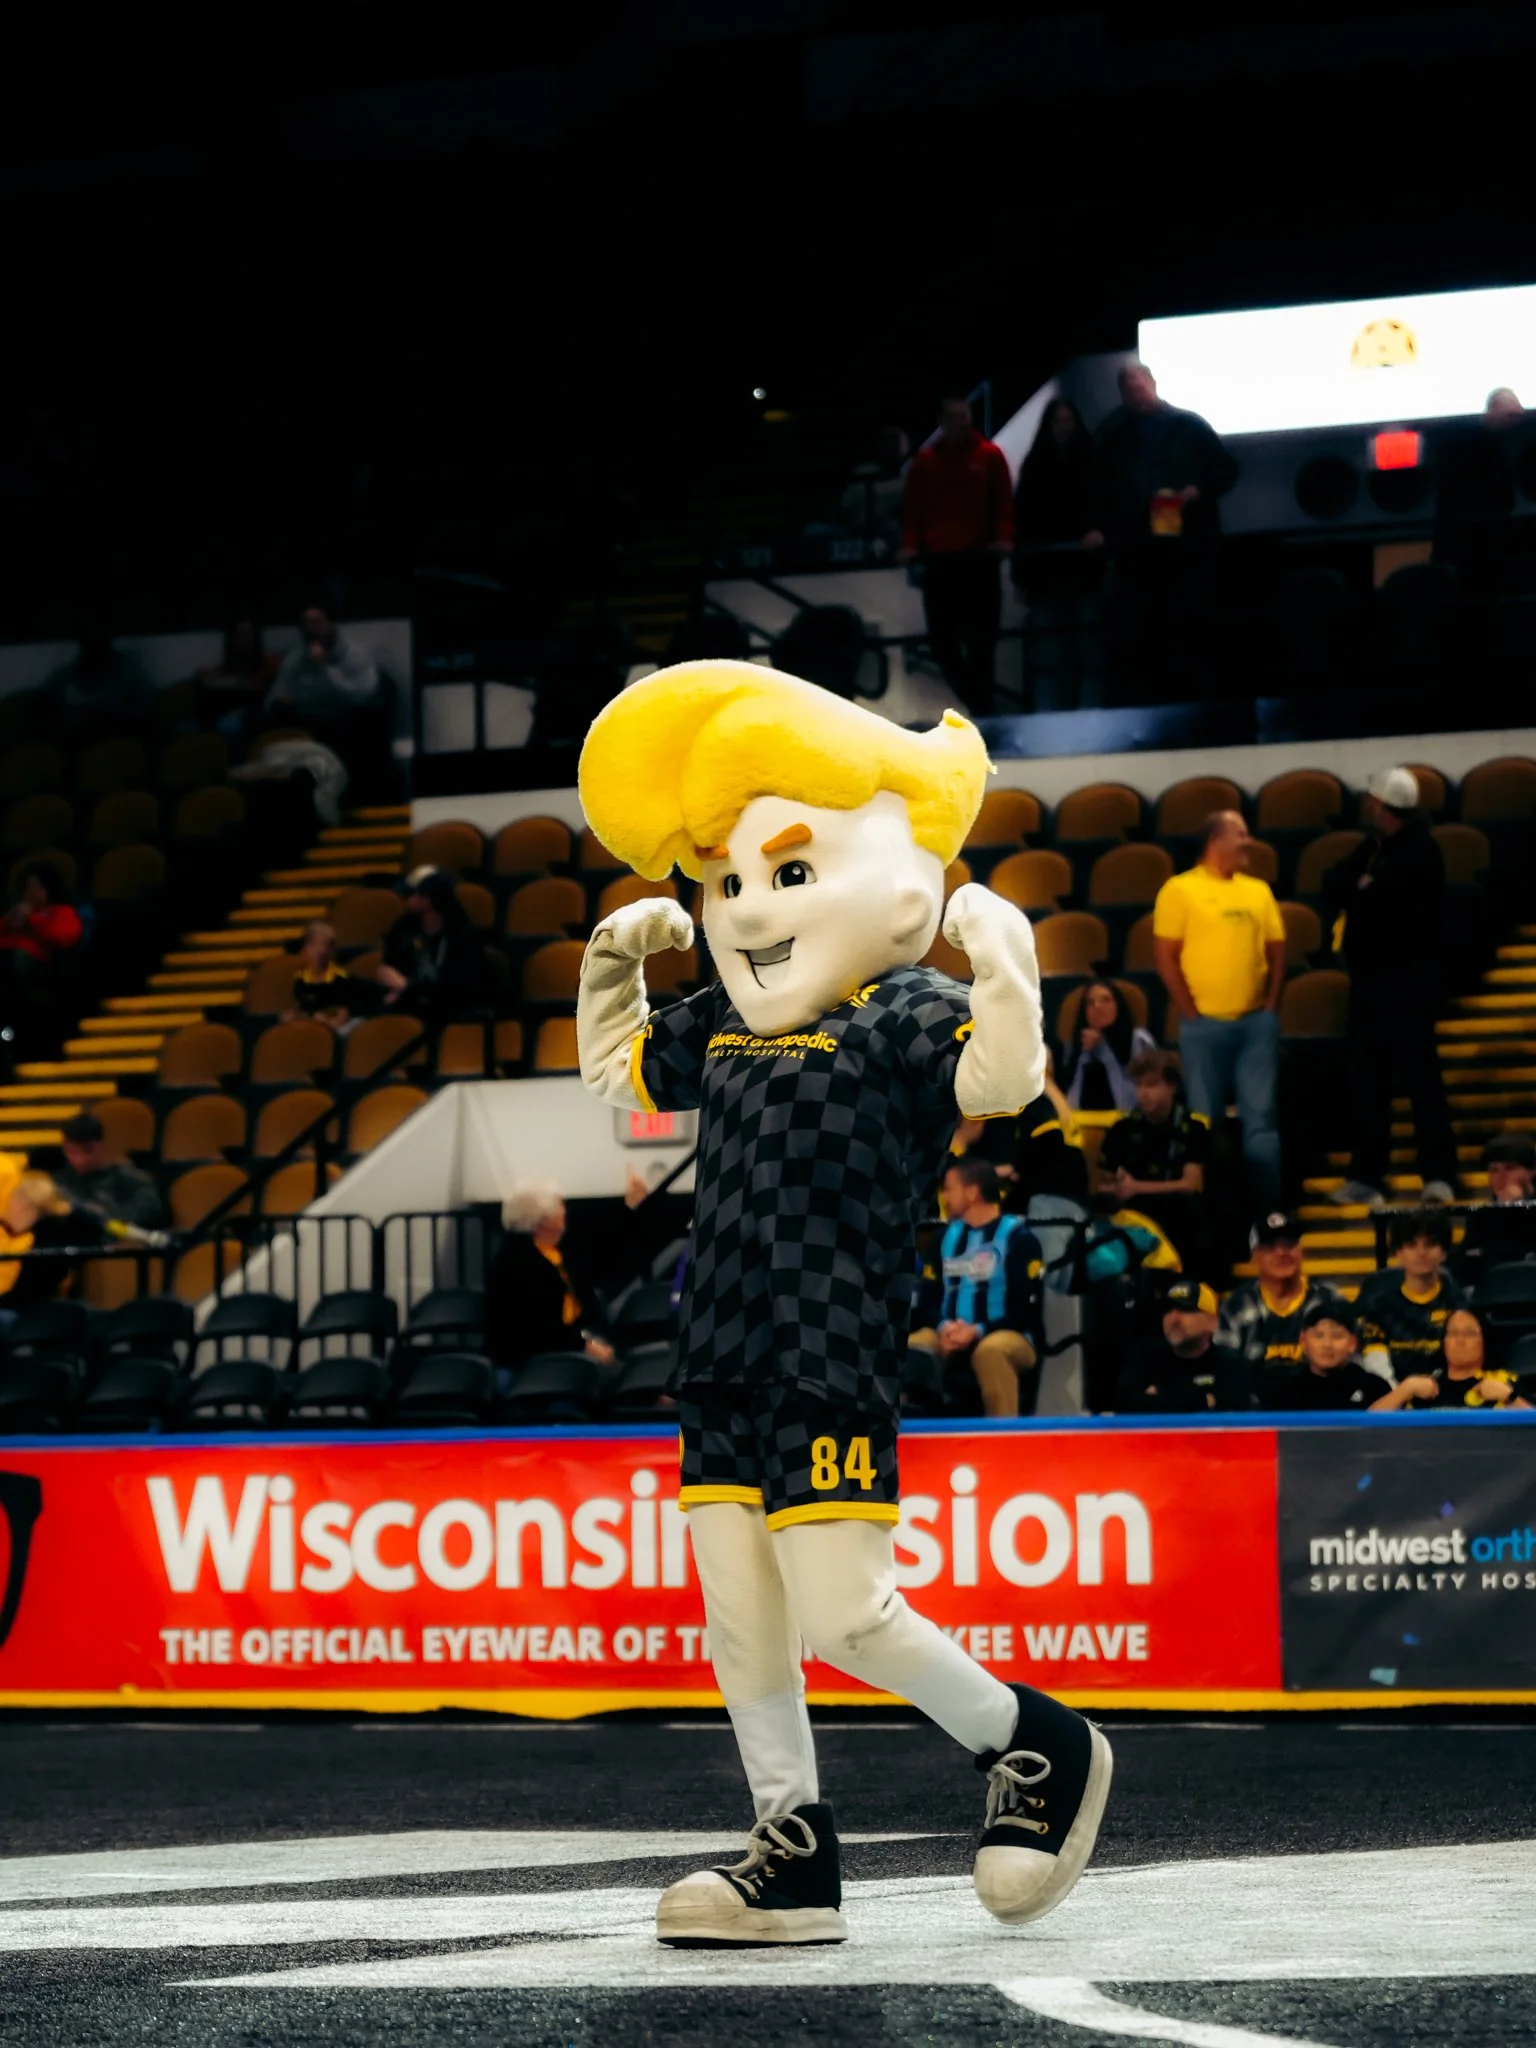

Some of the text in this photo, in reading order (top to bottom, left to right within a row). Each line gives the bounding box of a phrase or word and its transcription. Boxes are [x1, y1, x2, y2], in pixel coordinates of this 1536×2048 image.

[707, 1032, 753, 1049] idwest
[744, 1049, 806, 1060] HOSPITAL
[811, 1436, 877, 1491] 84
[893, 1464, 1152, 1588] sion
[1309, 1528, 1467, 1565] midwest
[1310, 1572, 1467, 1591] SPECIALTY
[161, 1628, 235, 1664] THE
[241, 1627, 413, 1663] OFFICIAL
[422, 1626, 604, 1662] EYEWEAR
[612, 1626, 667, 1662] OF
[1025, 1625, 1149, 1661] WAVE
